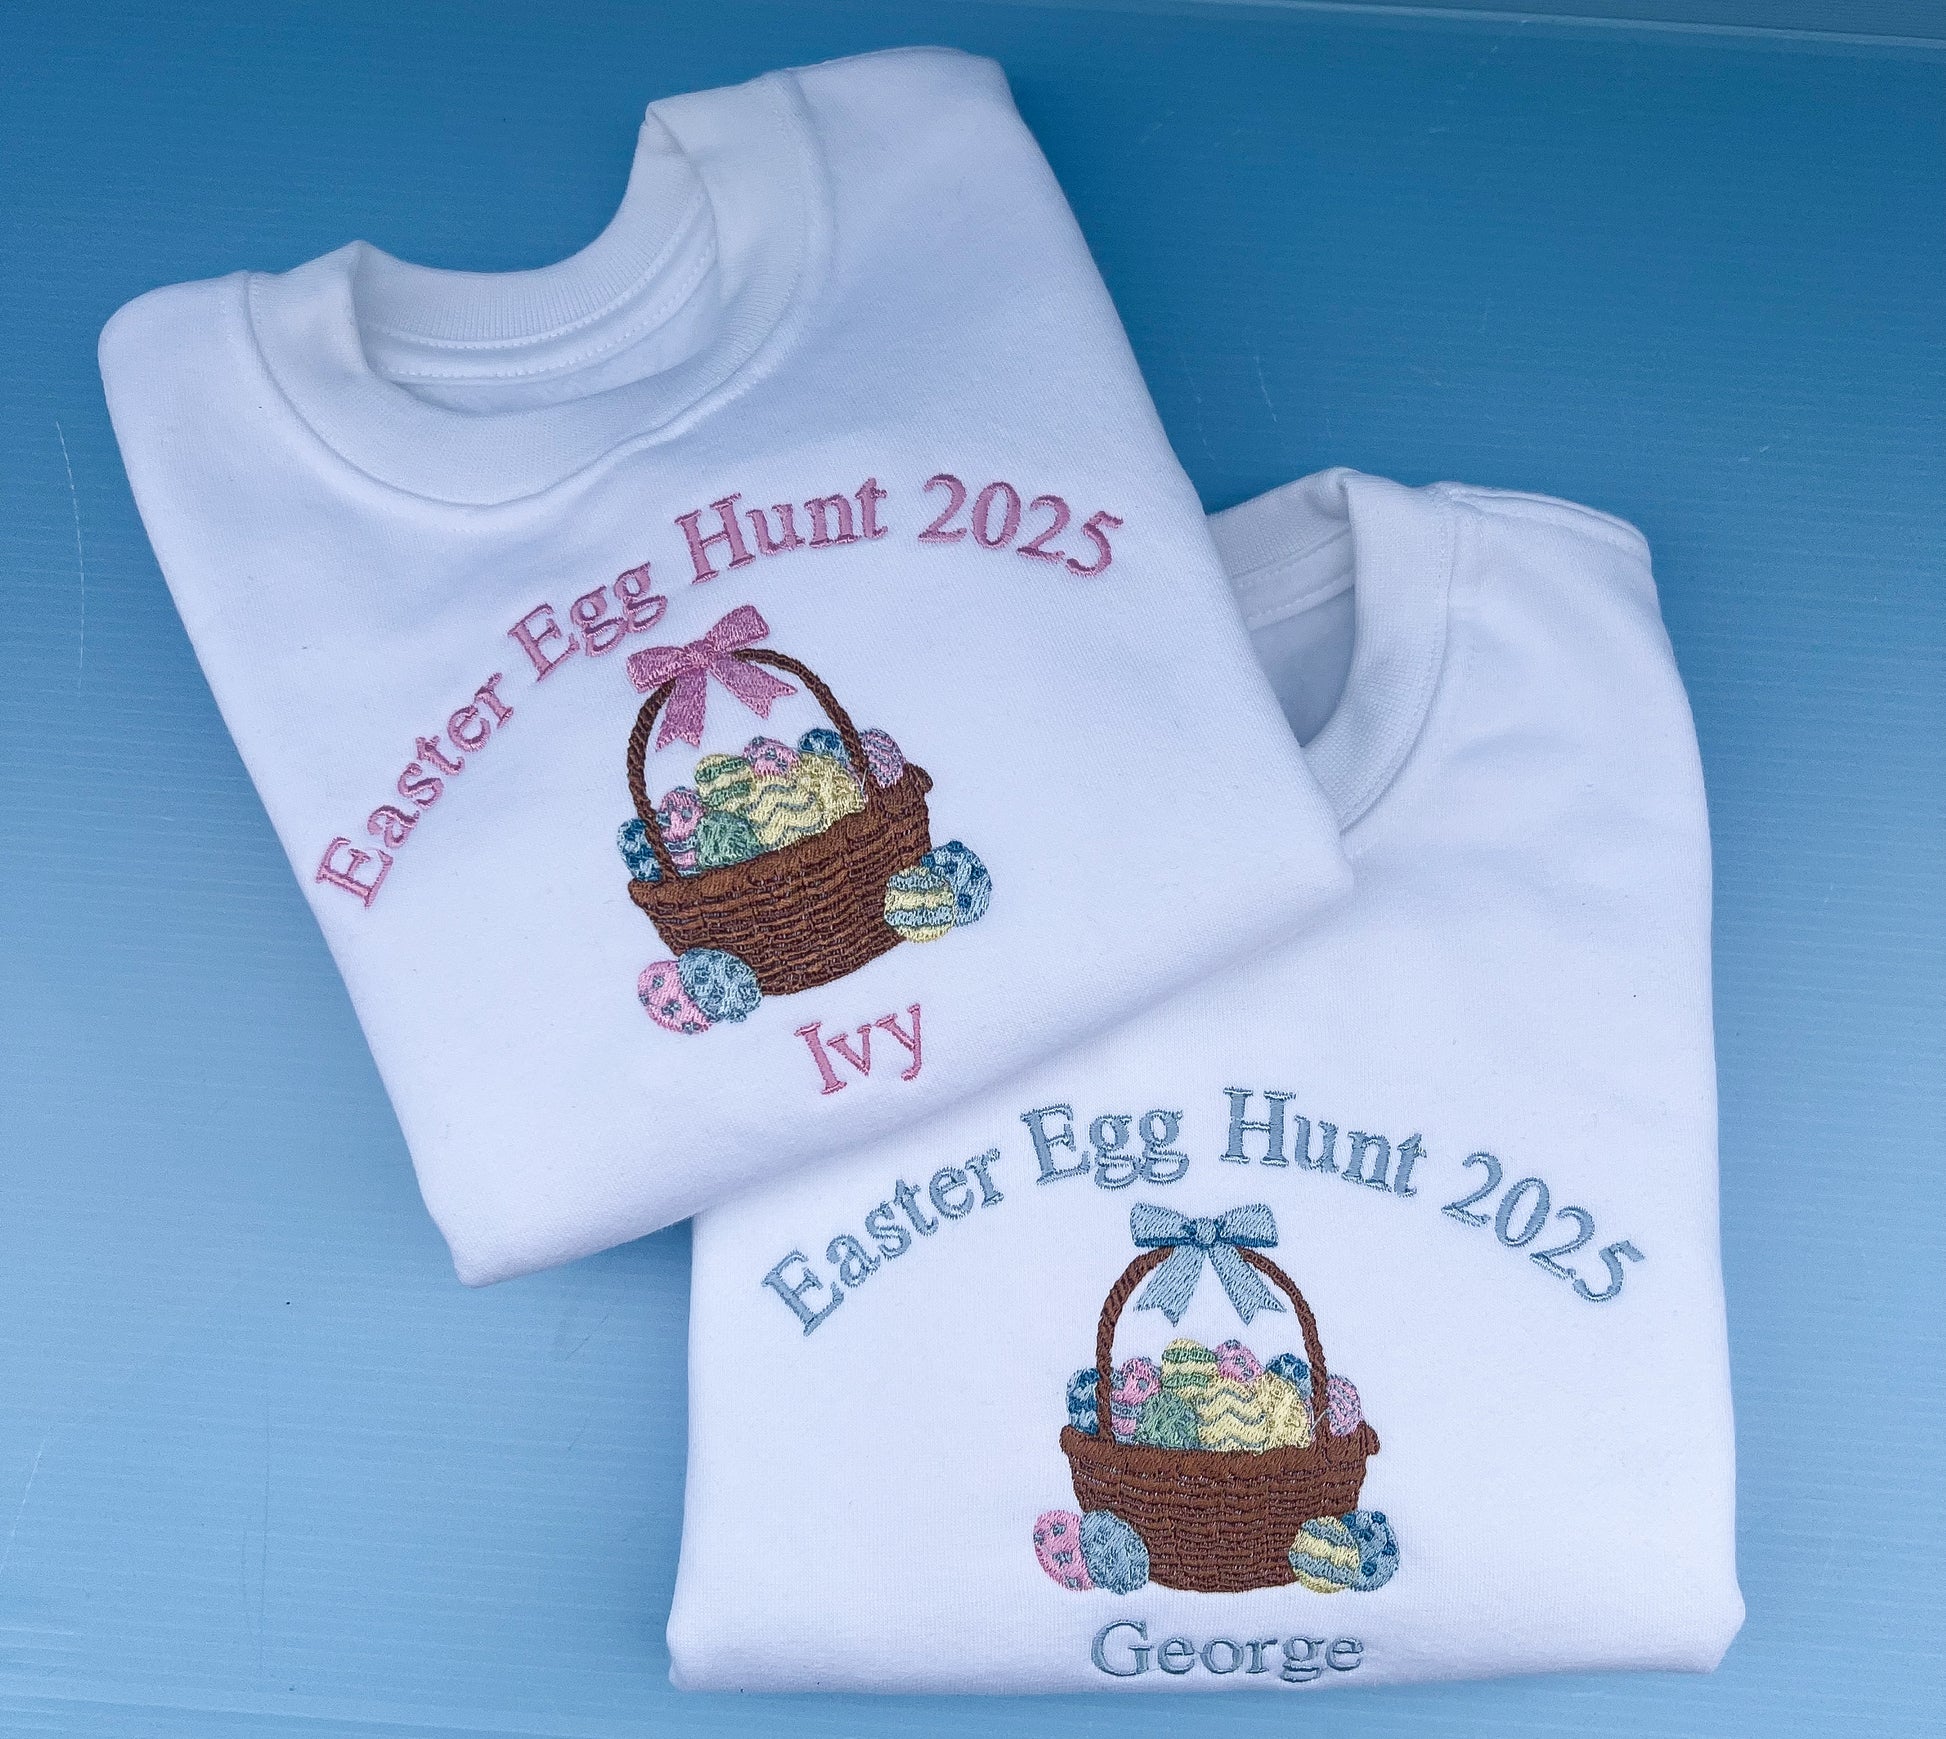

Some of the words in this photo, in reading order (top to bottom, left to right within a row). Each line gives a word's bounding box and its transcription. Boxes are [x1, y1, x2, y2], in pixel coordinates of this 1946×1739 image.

[317, 673, 514, 908] Easter
[507, 562, 668, 681] Egg
[674, 478, 888, 584] Hunt
[918, 474, 1124, 577] 2025
[795, 1004, 923, 1095] Ivy
[761, 1148, 1003, 1337] Easter
[1020, 1102, 1190, 1188] Egg
[1221, 1087, 1427, 1198] Hunt
[1441, 1151, 1647, 1303] 2025
[1091, 1620, 1363, 1683] George
